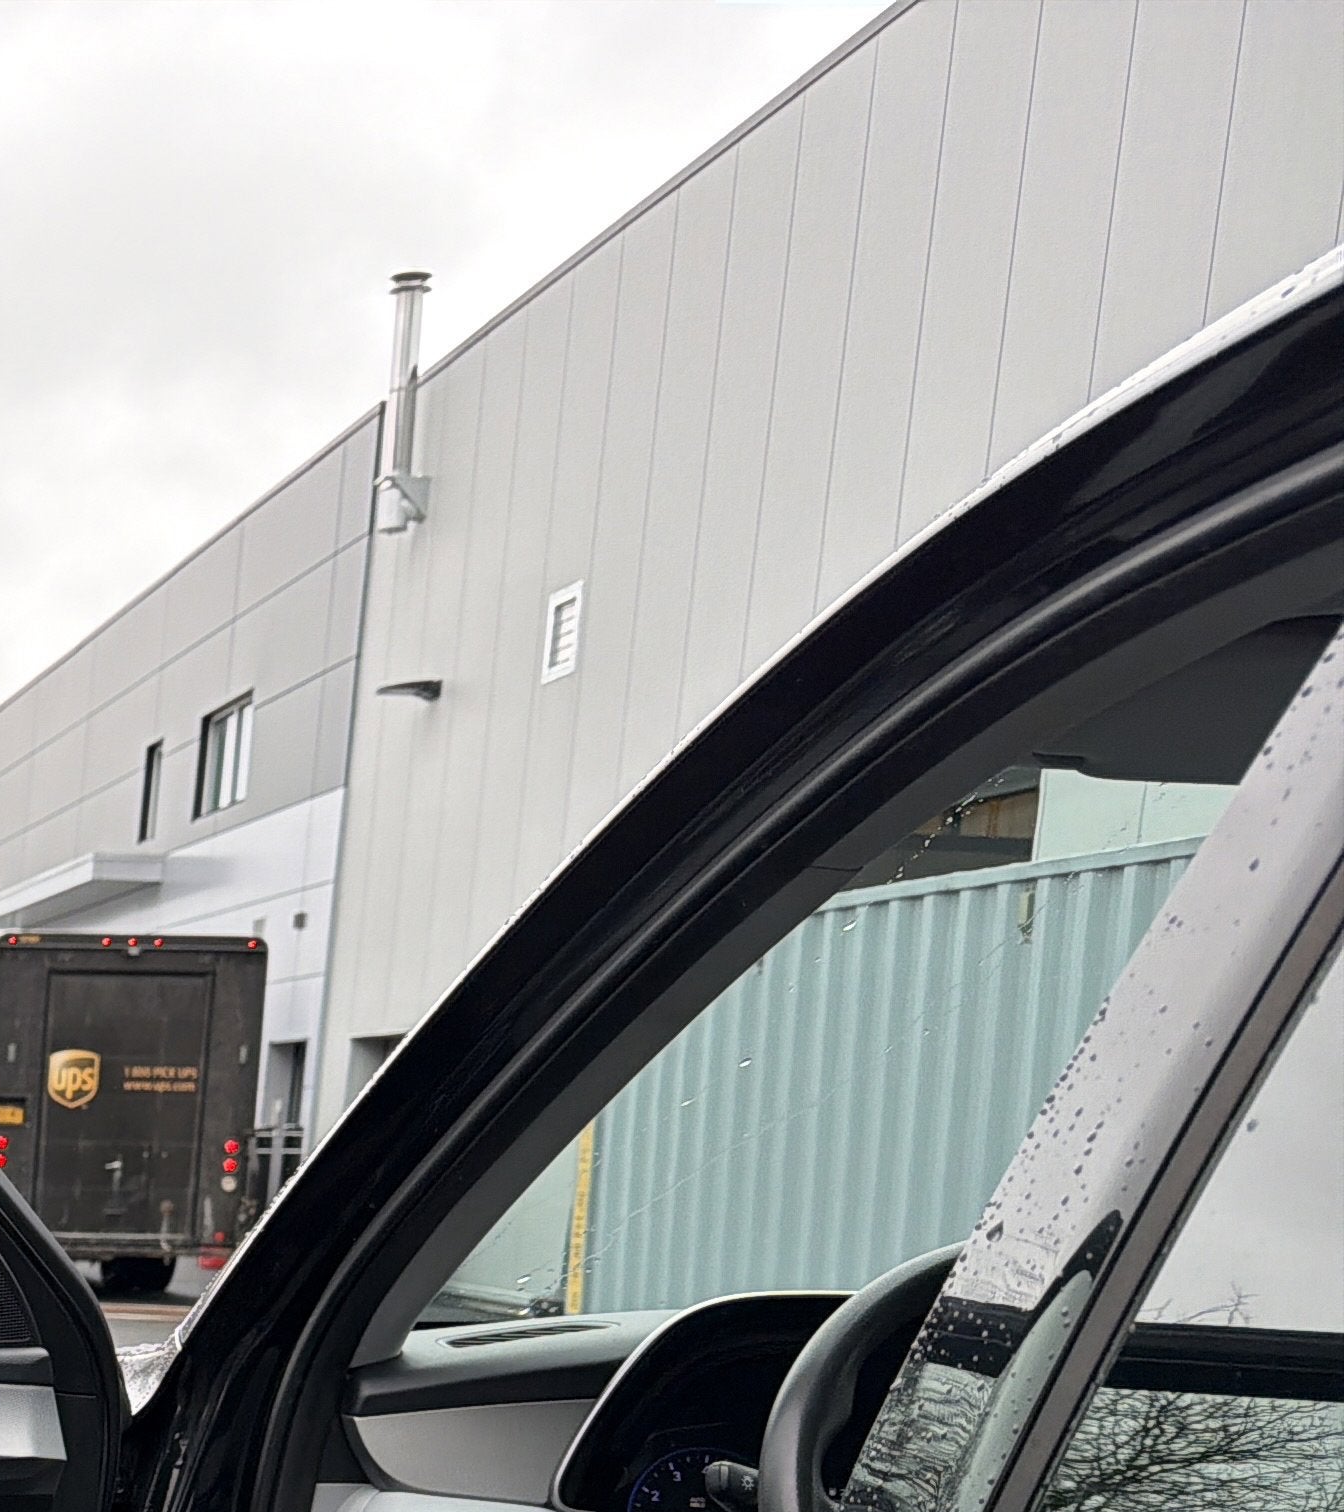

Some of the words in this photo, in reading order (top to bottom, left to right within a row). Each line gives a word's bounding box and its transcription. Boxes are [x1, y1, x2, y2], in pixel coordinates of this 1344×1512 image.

[54, 1067, 95, 1099] ups
[672, 1471, 682, 1482] 3
[651, 1490, 660, 1502] 2
